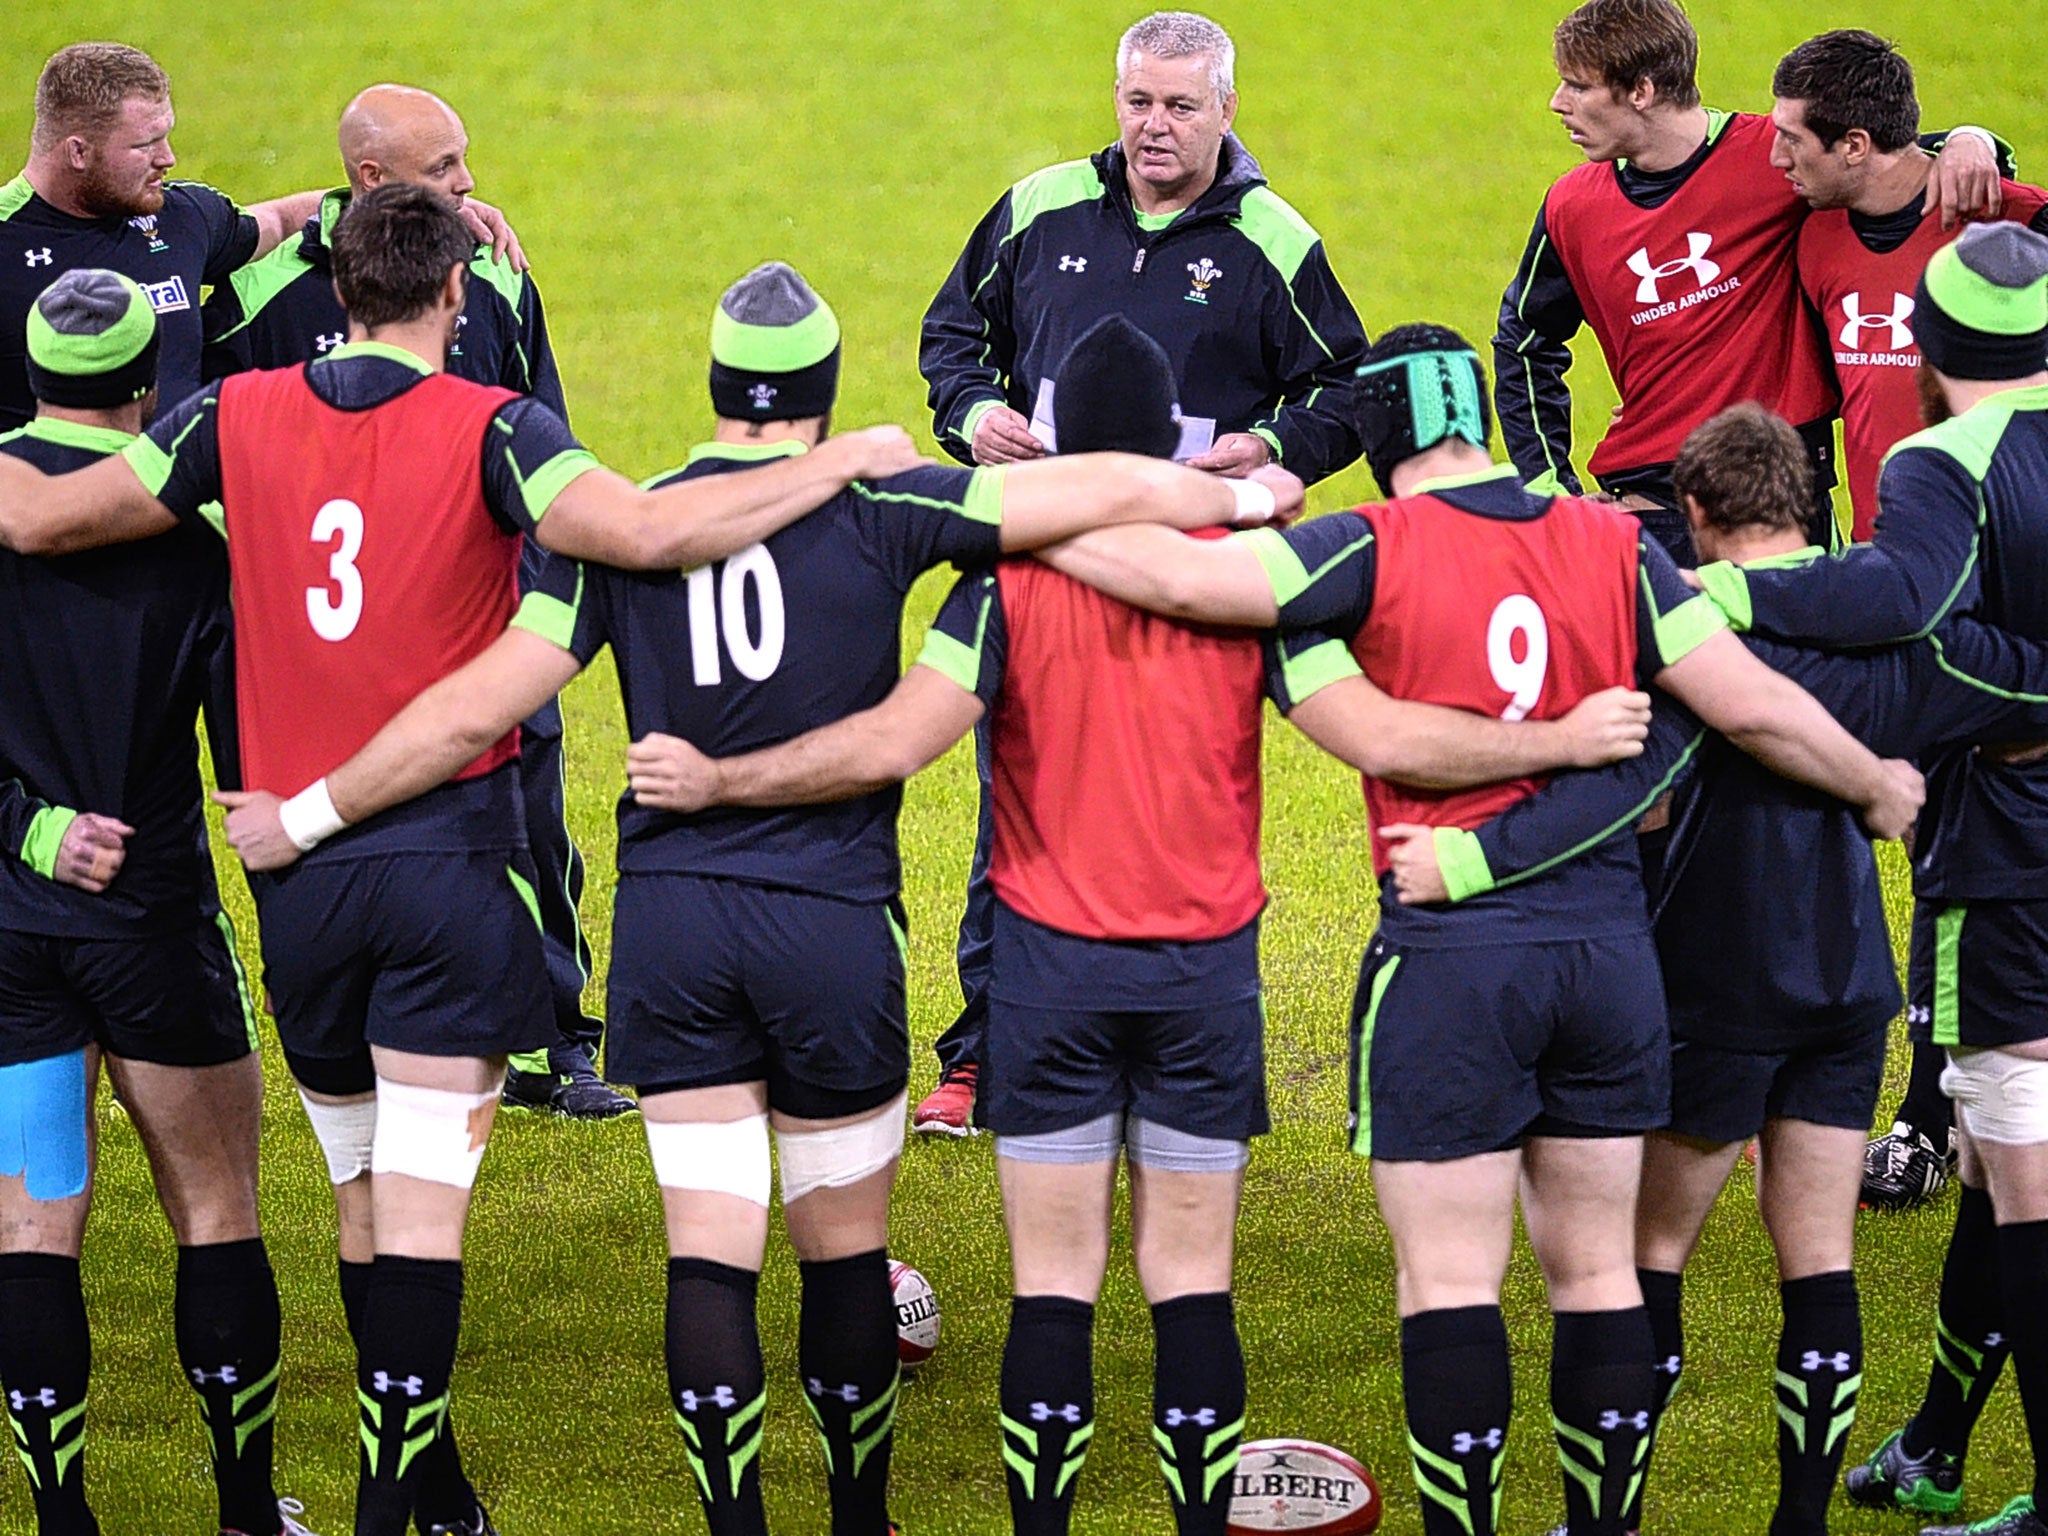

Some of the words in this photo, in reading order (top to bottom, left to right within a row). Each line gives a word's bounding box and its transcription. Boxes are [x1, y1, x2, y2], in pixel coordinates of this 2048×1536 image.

[1630, 301, 1678, 326] UNDER
[1679, 276, 1741, 310] ARMOUR
[305, 498, 365, 642] 3
[688, 542, 786, 687] 10
[1486, 593, 1549, 722] 9
[1231, 1473, 1356, 1503] LBERT
